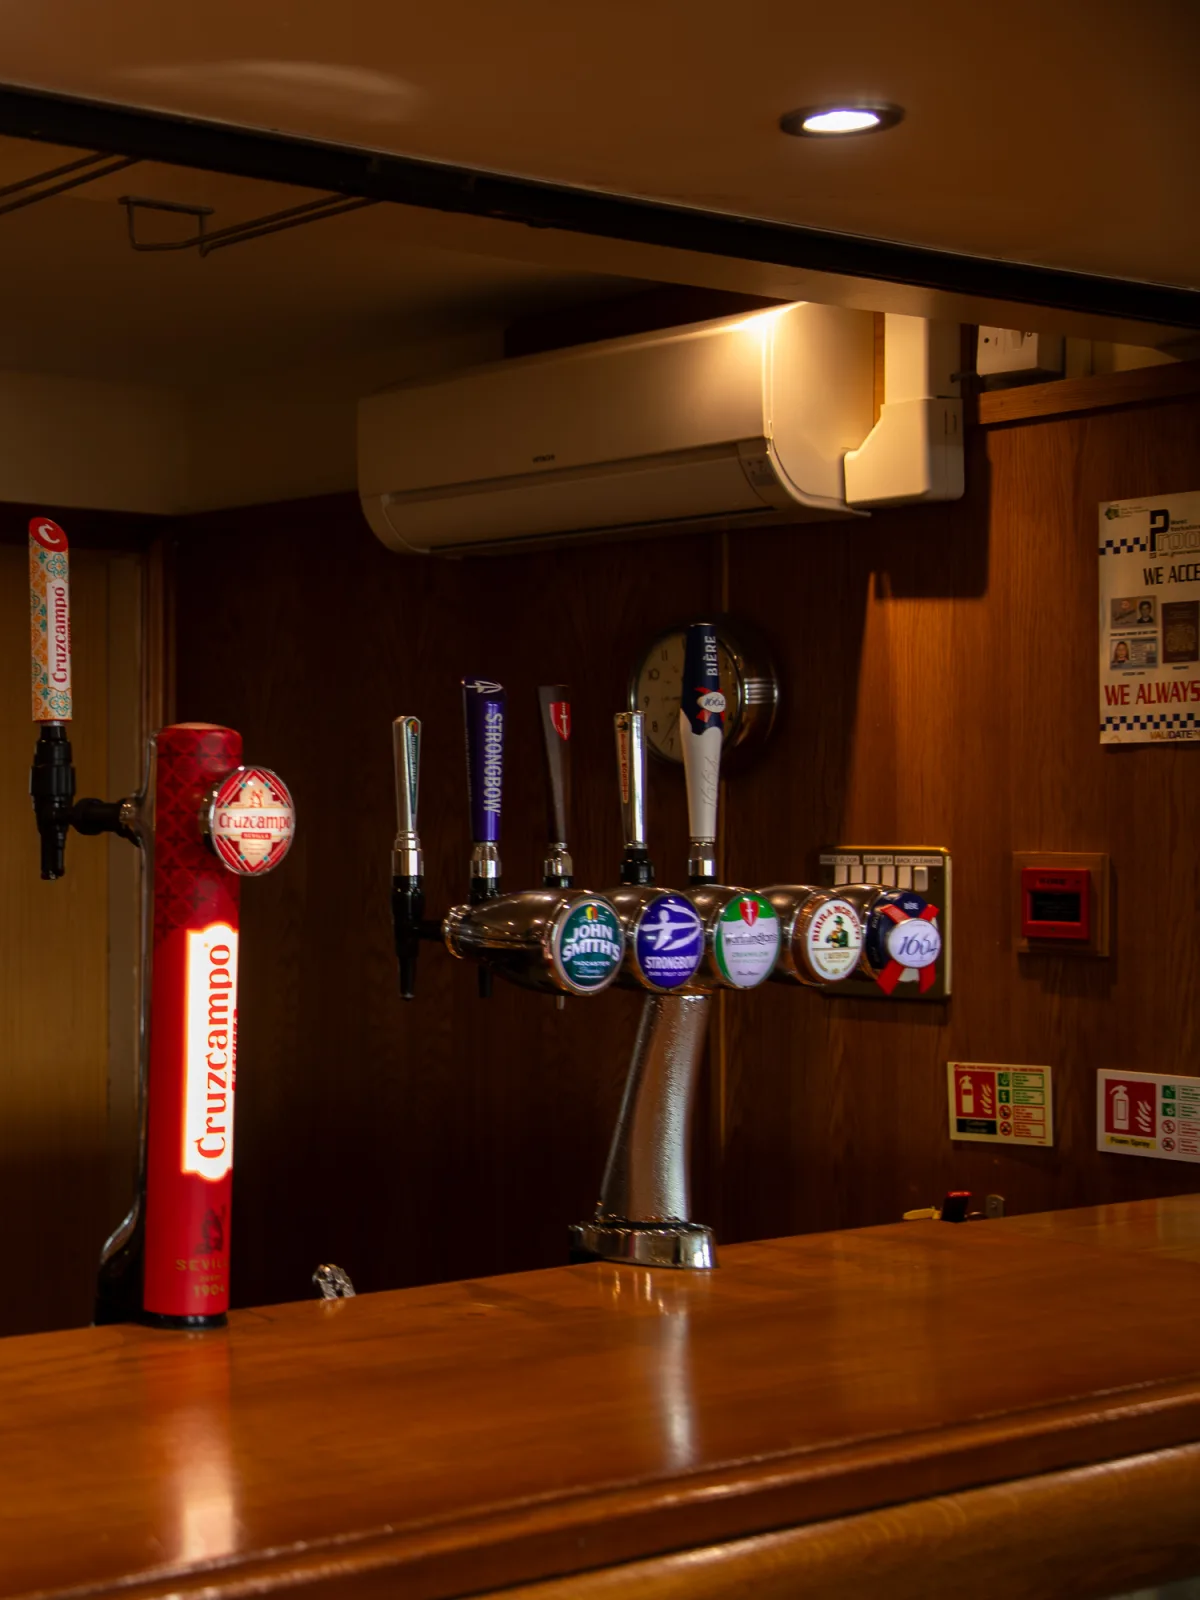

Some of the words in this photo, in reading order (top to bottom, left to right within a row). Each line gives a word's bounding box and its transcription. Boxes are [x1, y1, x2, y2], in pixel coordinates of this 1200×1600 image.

[1143, 566, 1164, 586] WE
[1168, 563, 1200, 583] ACCE
[51, 586, 68, 683] Cruzcampo
[1104, 684, 1130, 706] WE
[1136, 680, 1200, 705] ALWAYS
[483, 713, 503, 813] STRONGBOW
[572, 923, 613, 943] JOHN
[562, 938, 621, 962] SMITH'S
[644, 955, 699, 969] STRONGBOW
[194, 943, 232, 1159] Cruzcampo
